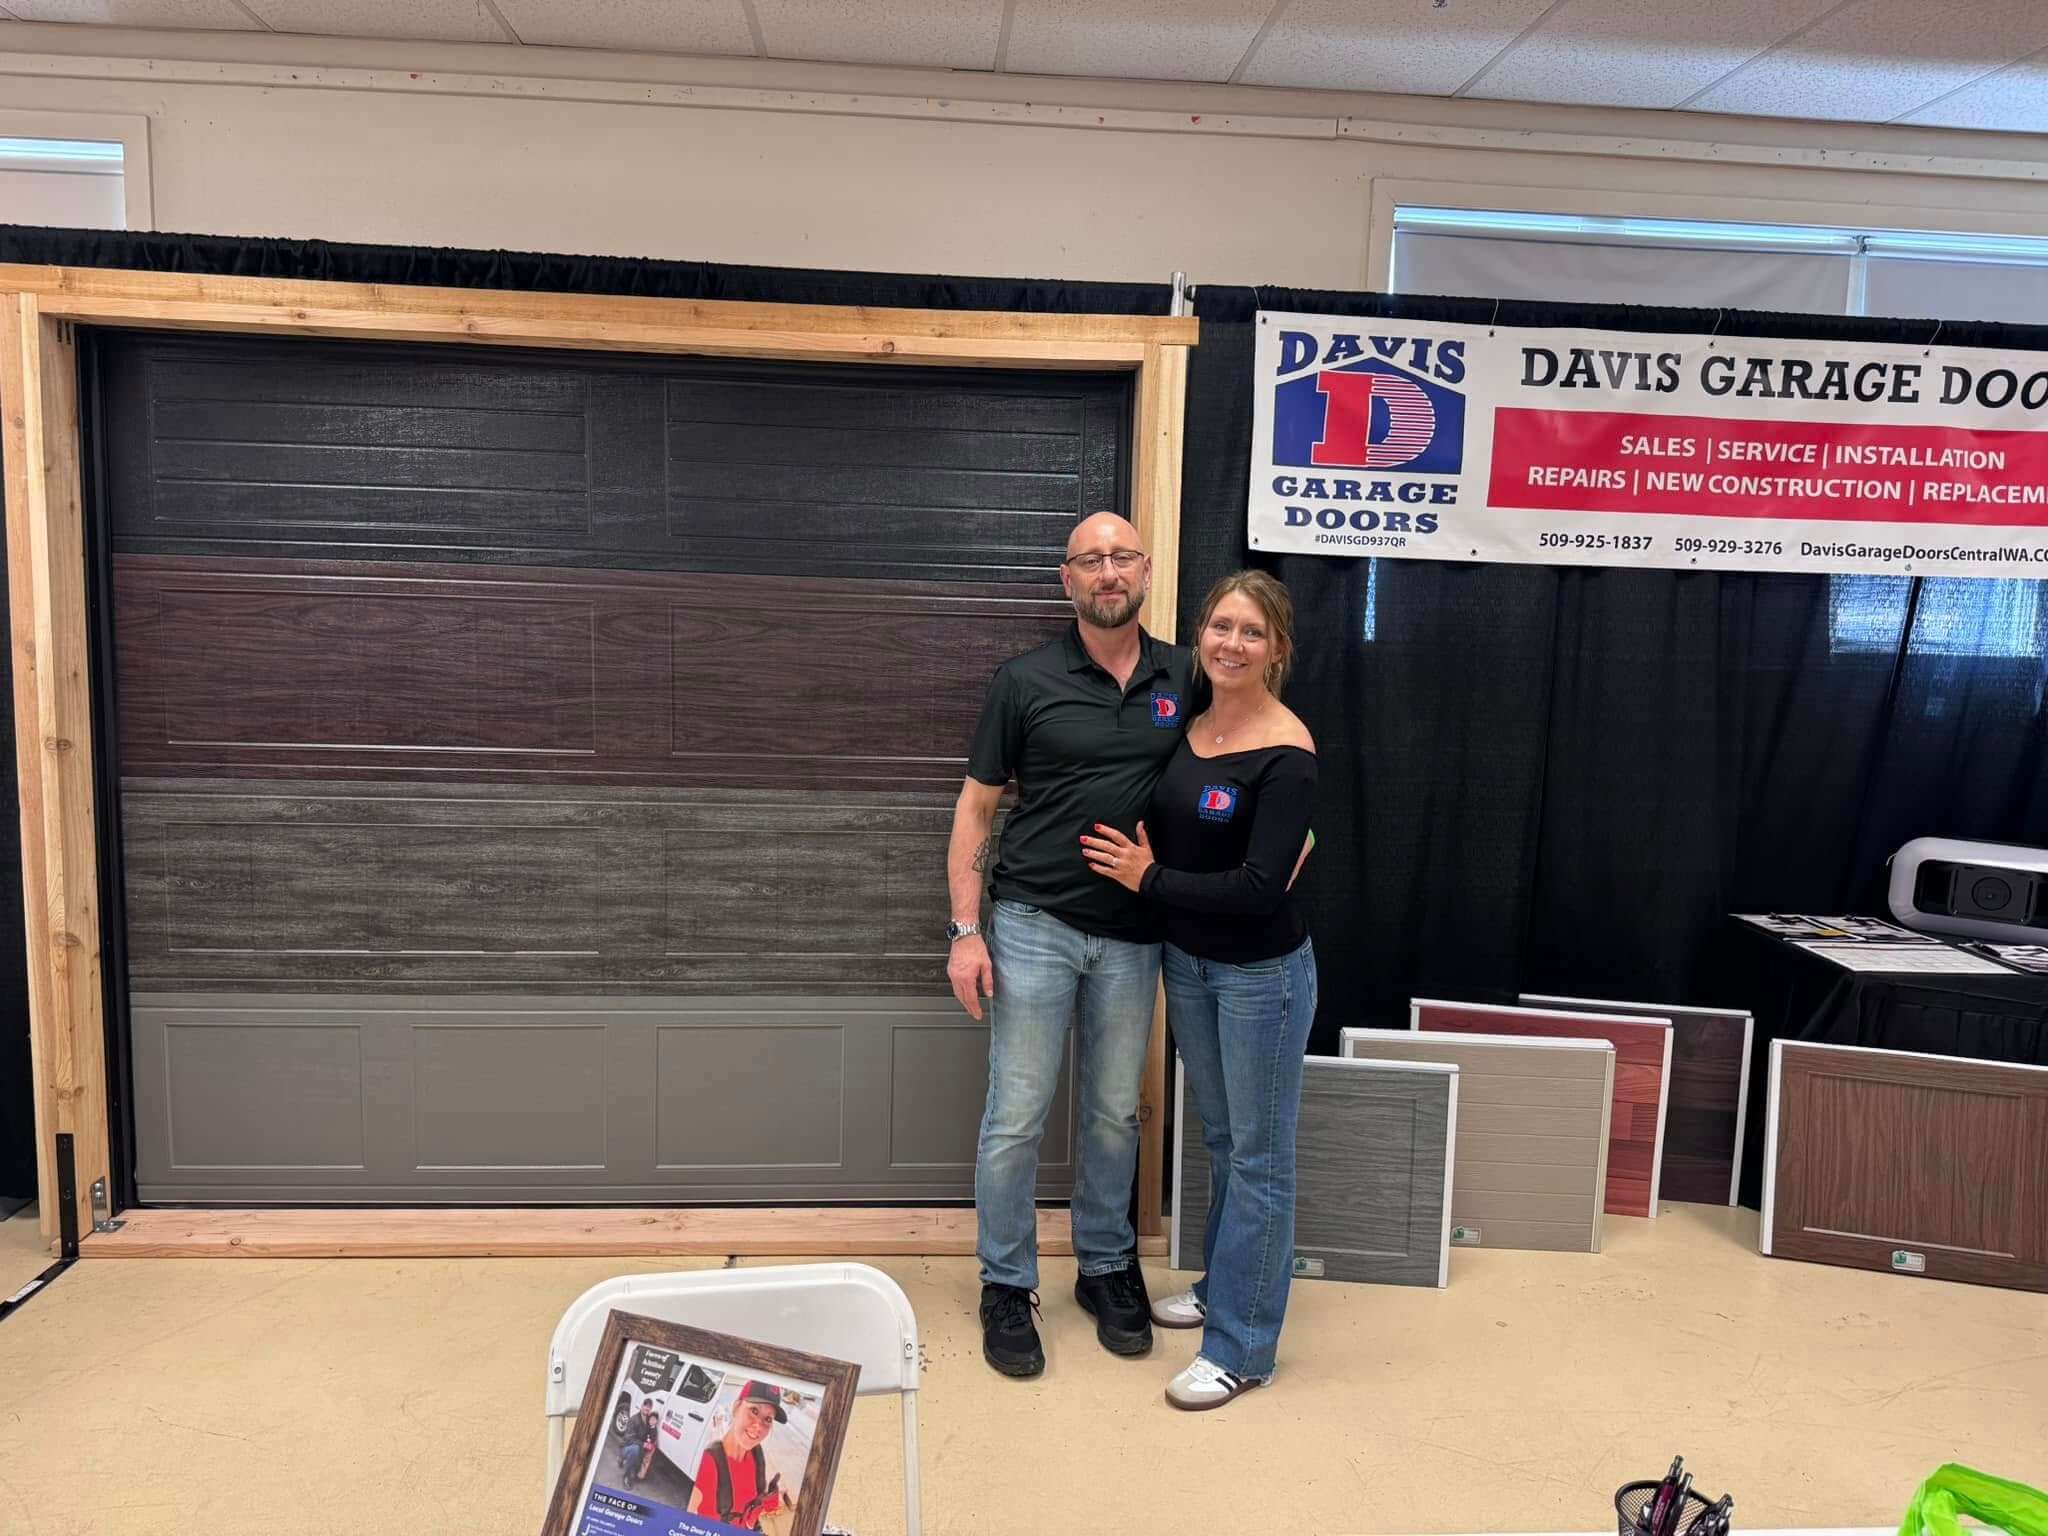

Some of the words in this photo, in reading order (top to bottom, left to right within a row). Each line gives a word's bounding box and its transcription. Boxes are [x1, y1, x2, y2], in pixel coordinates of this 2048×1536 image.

[1276, 330, 1466, 384] DAVIS
[1520, 347, 1682, 393] DAVIS
[1699, 354, 1921, 402] GARAGE
[1311, 370, 1436, 468] D
[1620, 436, 1696, 457] SALES
[1717, 440, 1818, 463] SERVICE
[1835, 445, 2005, 470] INSTALLATION
[1272, 475, 1459, 505] GARAGE
[1528, 466, 1627, 489] REPAIRS
[1646, 471, 1704, 492] NEW
[1708, 474, 1901, 500] CONSTRUCTION
[1923, 482, 2048, 504] REPLACEM
[1284, 506, 1439, 534] DOORS
[1314, 533, 1407, 548] #DAVISGD937QR
[1539, 532, 1653, 551] 509-925-1837
[1675, 537, 1783, 556] 509-929-3276
[594, 1493, 607, 1503] THE
[608, 1497, 626, 1509] FACE
